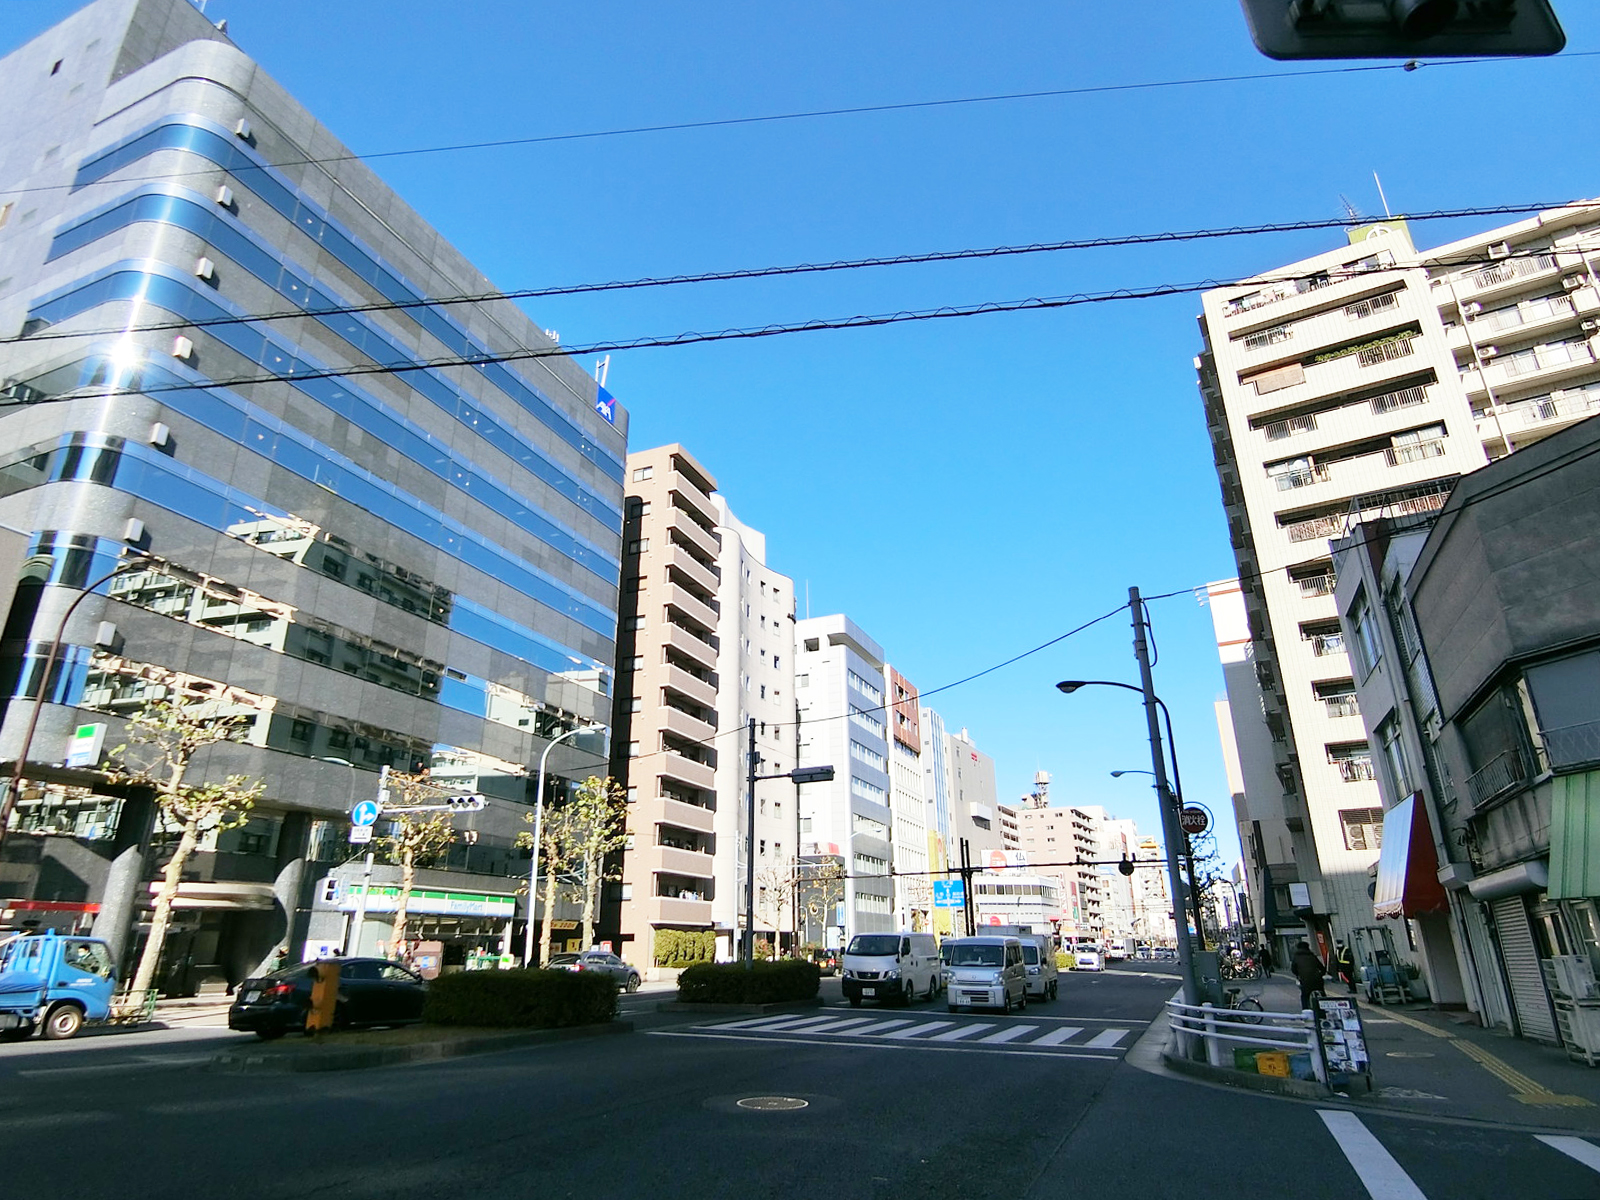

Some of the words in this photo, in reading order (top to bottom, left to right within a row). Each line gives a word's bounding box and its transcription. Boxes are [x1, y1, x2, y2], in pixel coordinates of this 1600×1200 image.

[1182, 814, 1206, 826] 消火栓
[450, 901, 483, 913] FamilyMart
